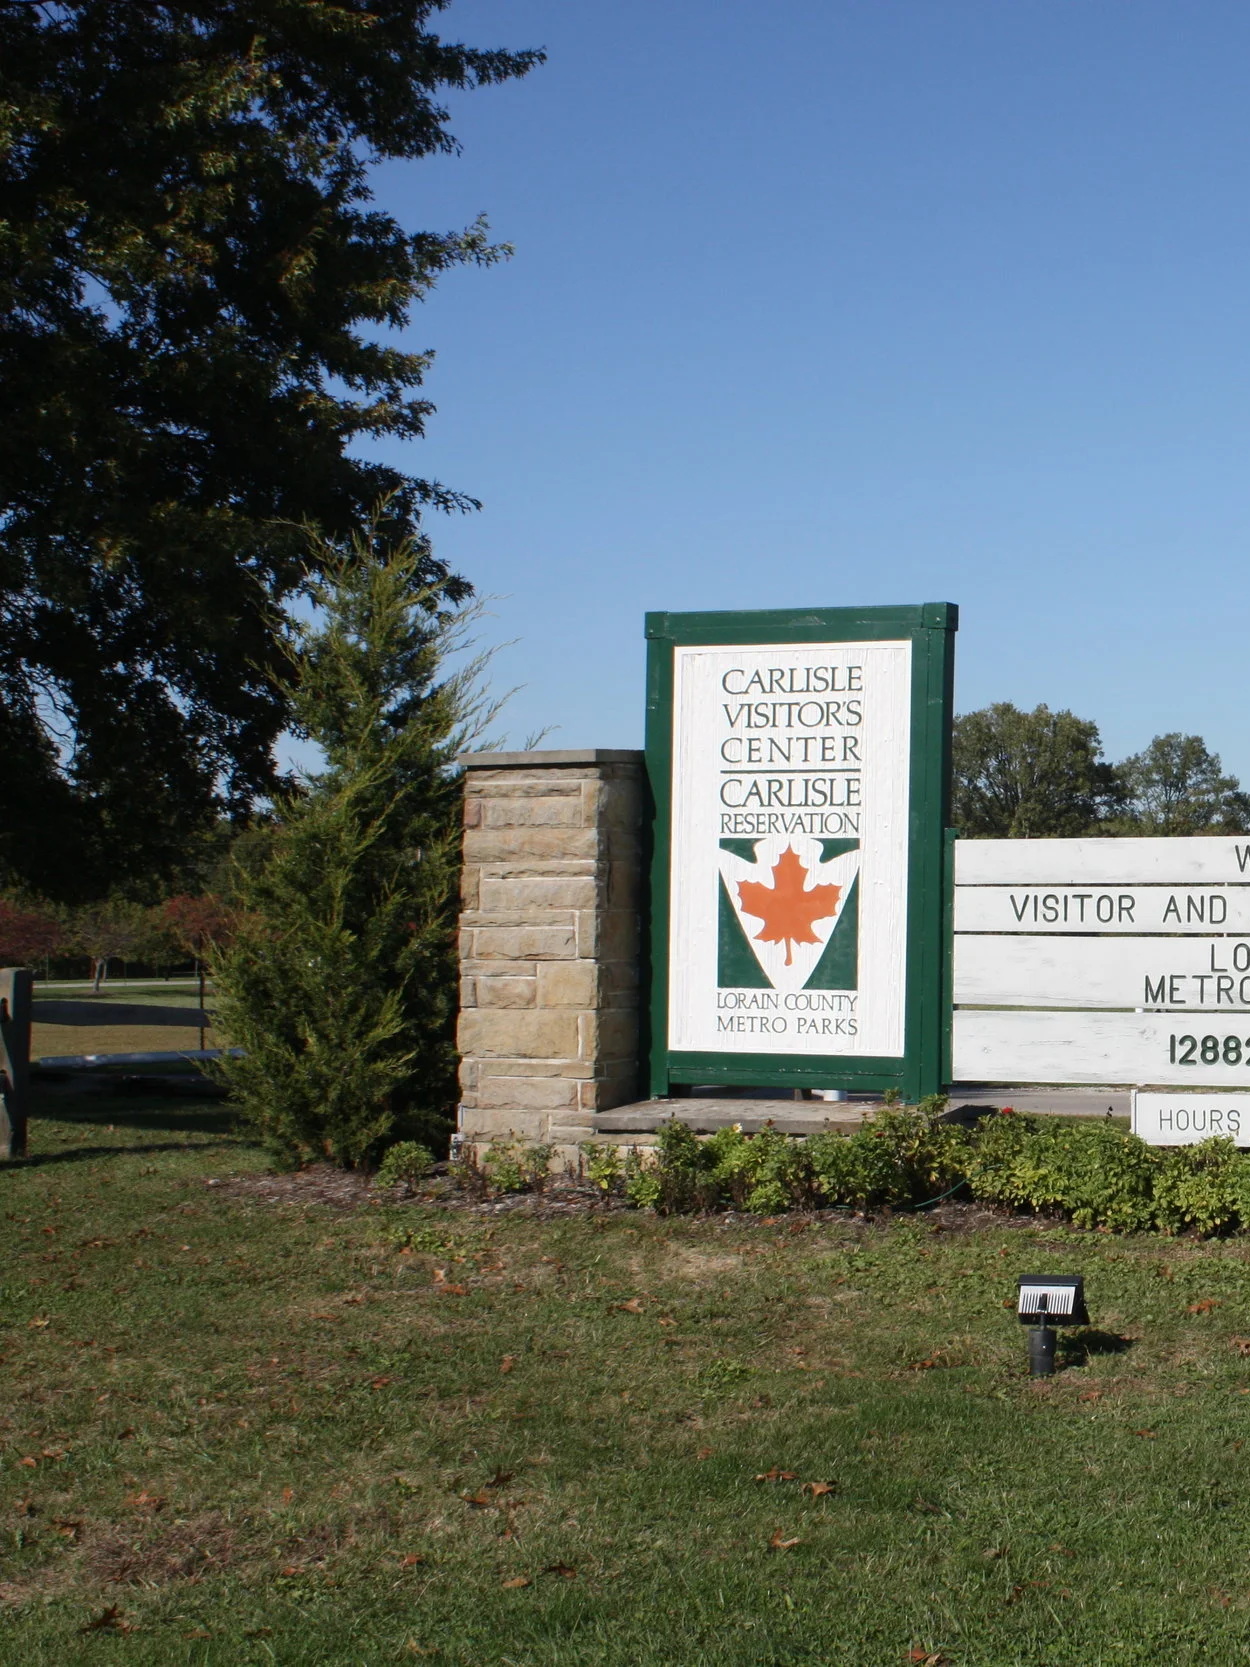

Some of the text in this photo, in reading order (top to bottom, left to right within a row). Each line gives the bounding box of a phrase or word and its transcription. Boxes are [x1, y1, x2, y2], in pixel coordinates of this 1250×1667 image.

[722, 666, 863, 695] CARLISLE
[722, 700, 862, 729] VISITOR'S
[720, 735, 862, 764] CENTER
[719, 777, 862, 808] CARLISLE
[719, 812, 860, 834] RESERVATION
[1009, 893, 1136, 923] VISITOR
[1162, 894, 1228, 924] AND
[716, 992, 858, 1013] LORAIN COUNTY
[717, 1015, 858, 1036] METRO PARKS
[1158, 1109, 1241, 1132] HOURS
